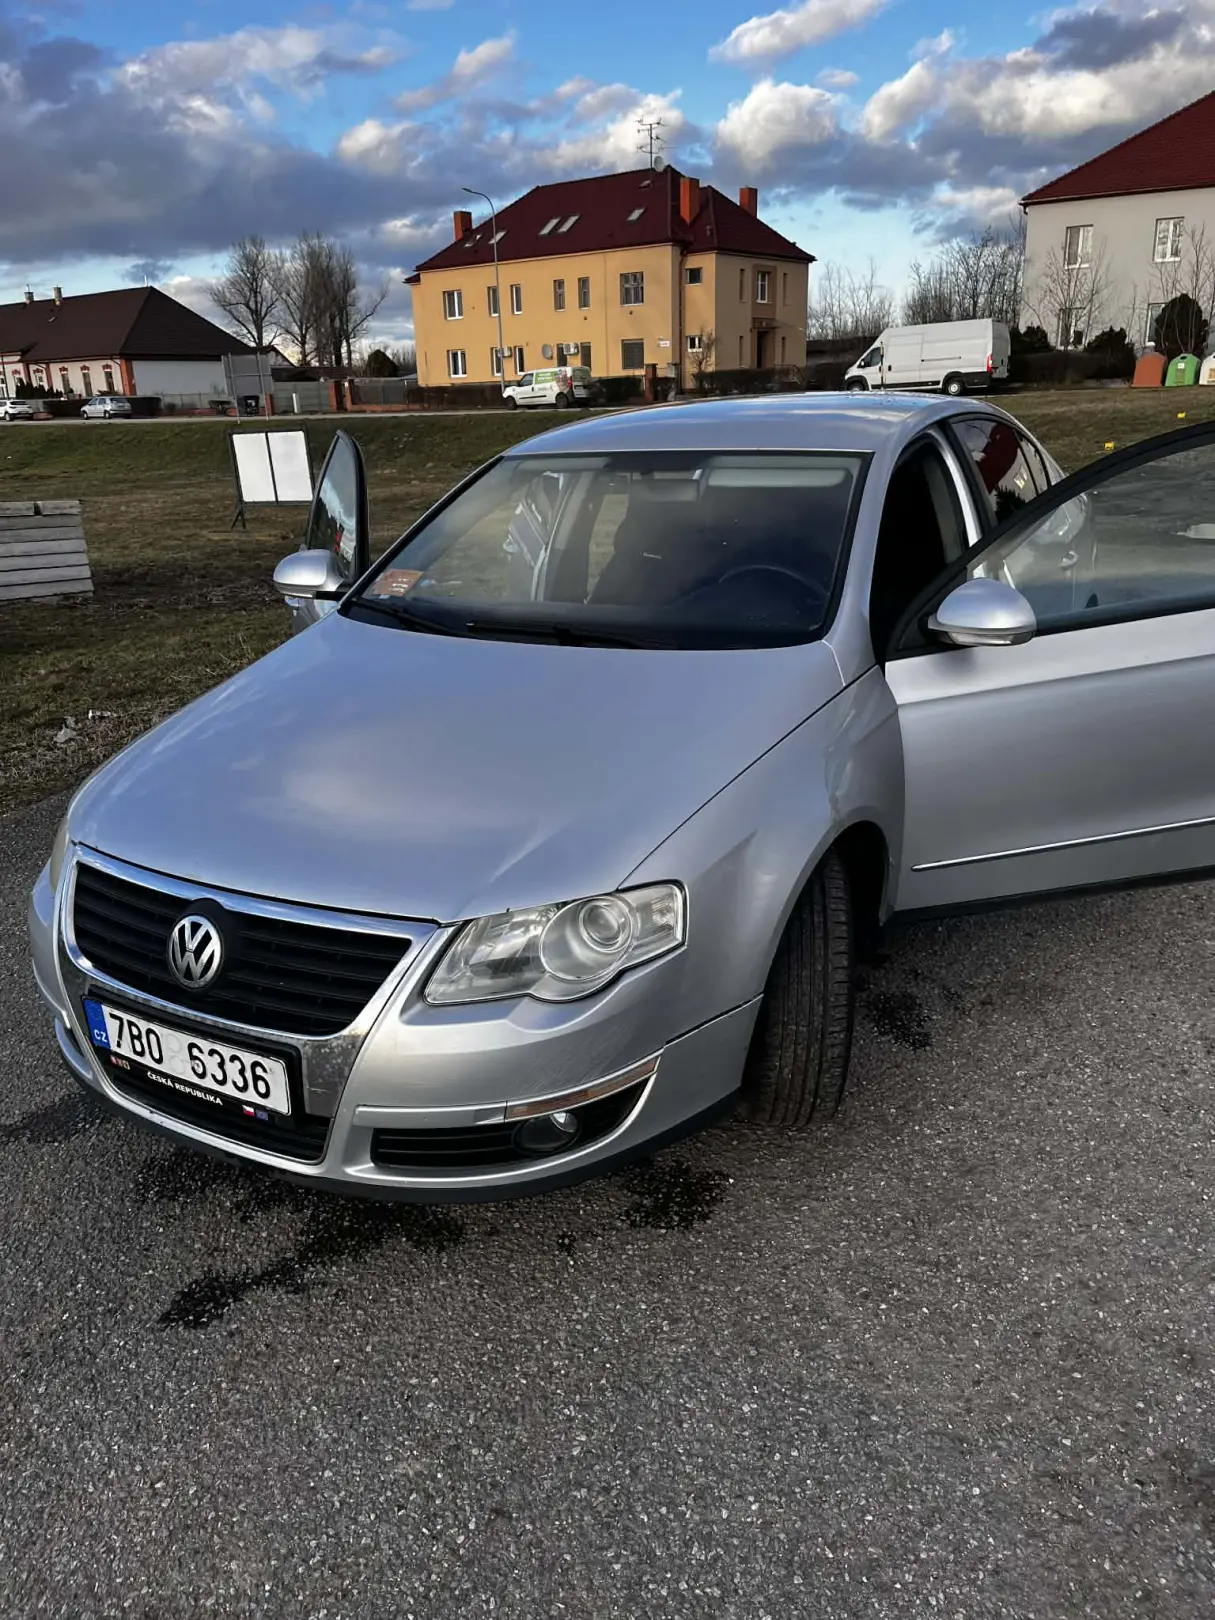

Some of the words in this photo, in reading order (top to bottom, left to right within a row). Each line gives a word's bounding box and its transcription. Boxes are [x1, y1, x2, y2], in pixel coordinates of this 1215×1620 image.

[93, 1029, 108, 1043] CZ
[187, 1042, 271, 1100] 6336
[175, 1083, 223, 1106] REPUBLIKA
